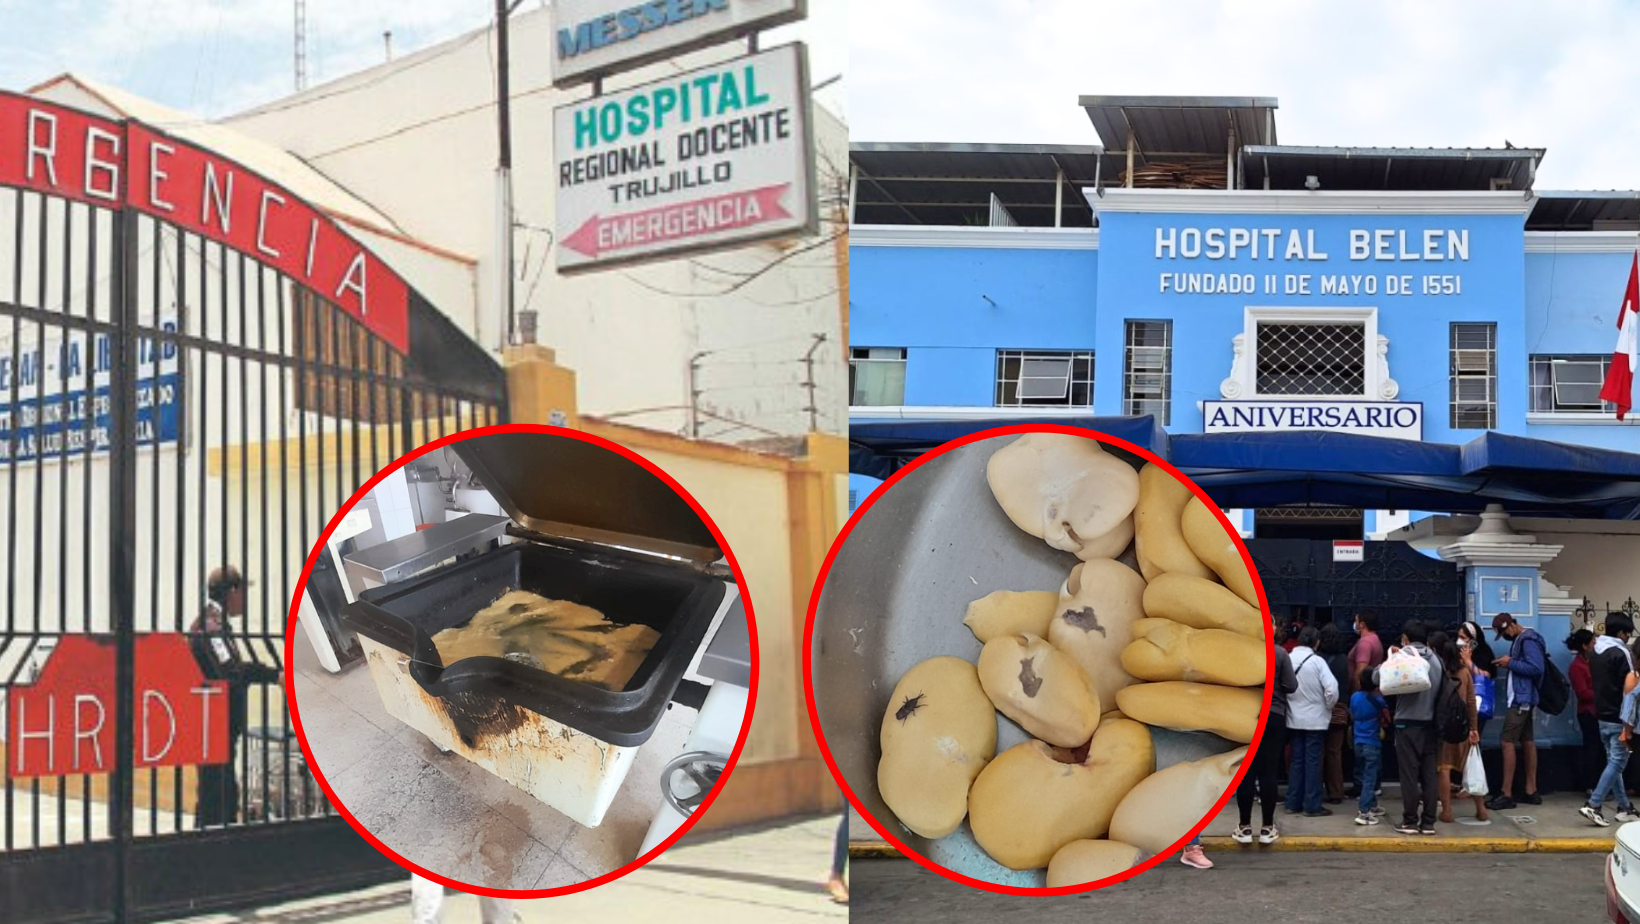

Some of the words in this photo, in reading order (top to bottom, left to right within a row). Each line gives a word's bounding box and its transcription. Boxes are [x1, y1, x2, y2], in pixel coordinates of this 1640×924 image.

[574, 64, 770, 151] HOSPITAL
[560, 140, 666, 188] REGIONAL
[678, 107, 790, 161] DOCENTE
[608, 161, 732, 204] TRUJILLO
[597, 195, 762, 248] EMERGENCIA
[1155, 227, 1328, 260] HOSPITAL
[1348, 228, 1470, 261] BELEN
[1159, 273, 1256, 295] FUNDADO
[1284, 274, 1312, 295] DE
[1320, 275, 1378, 296] MAYO
[1385, 275, 1414, 296] DE
[1421, 275, 1462, 296] 1551
[1208, 406, 1417, 428] ANIVERSARIO
